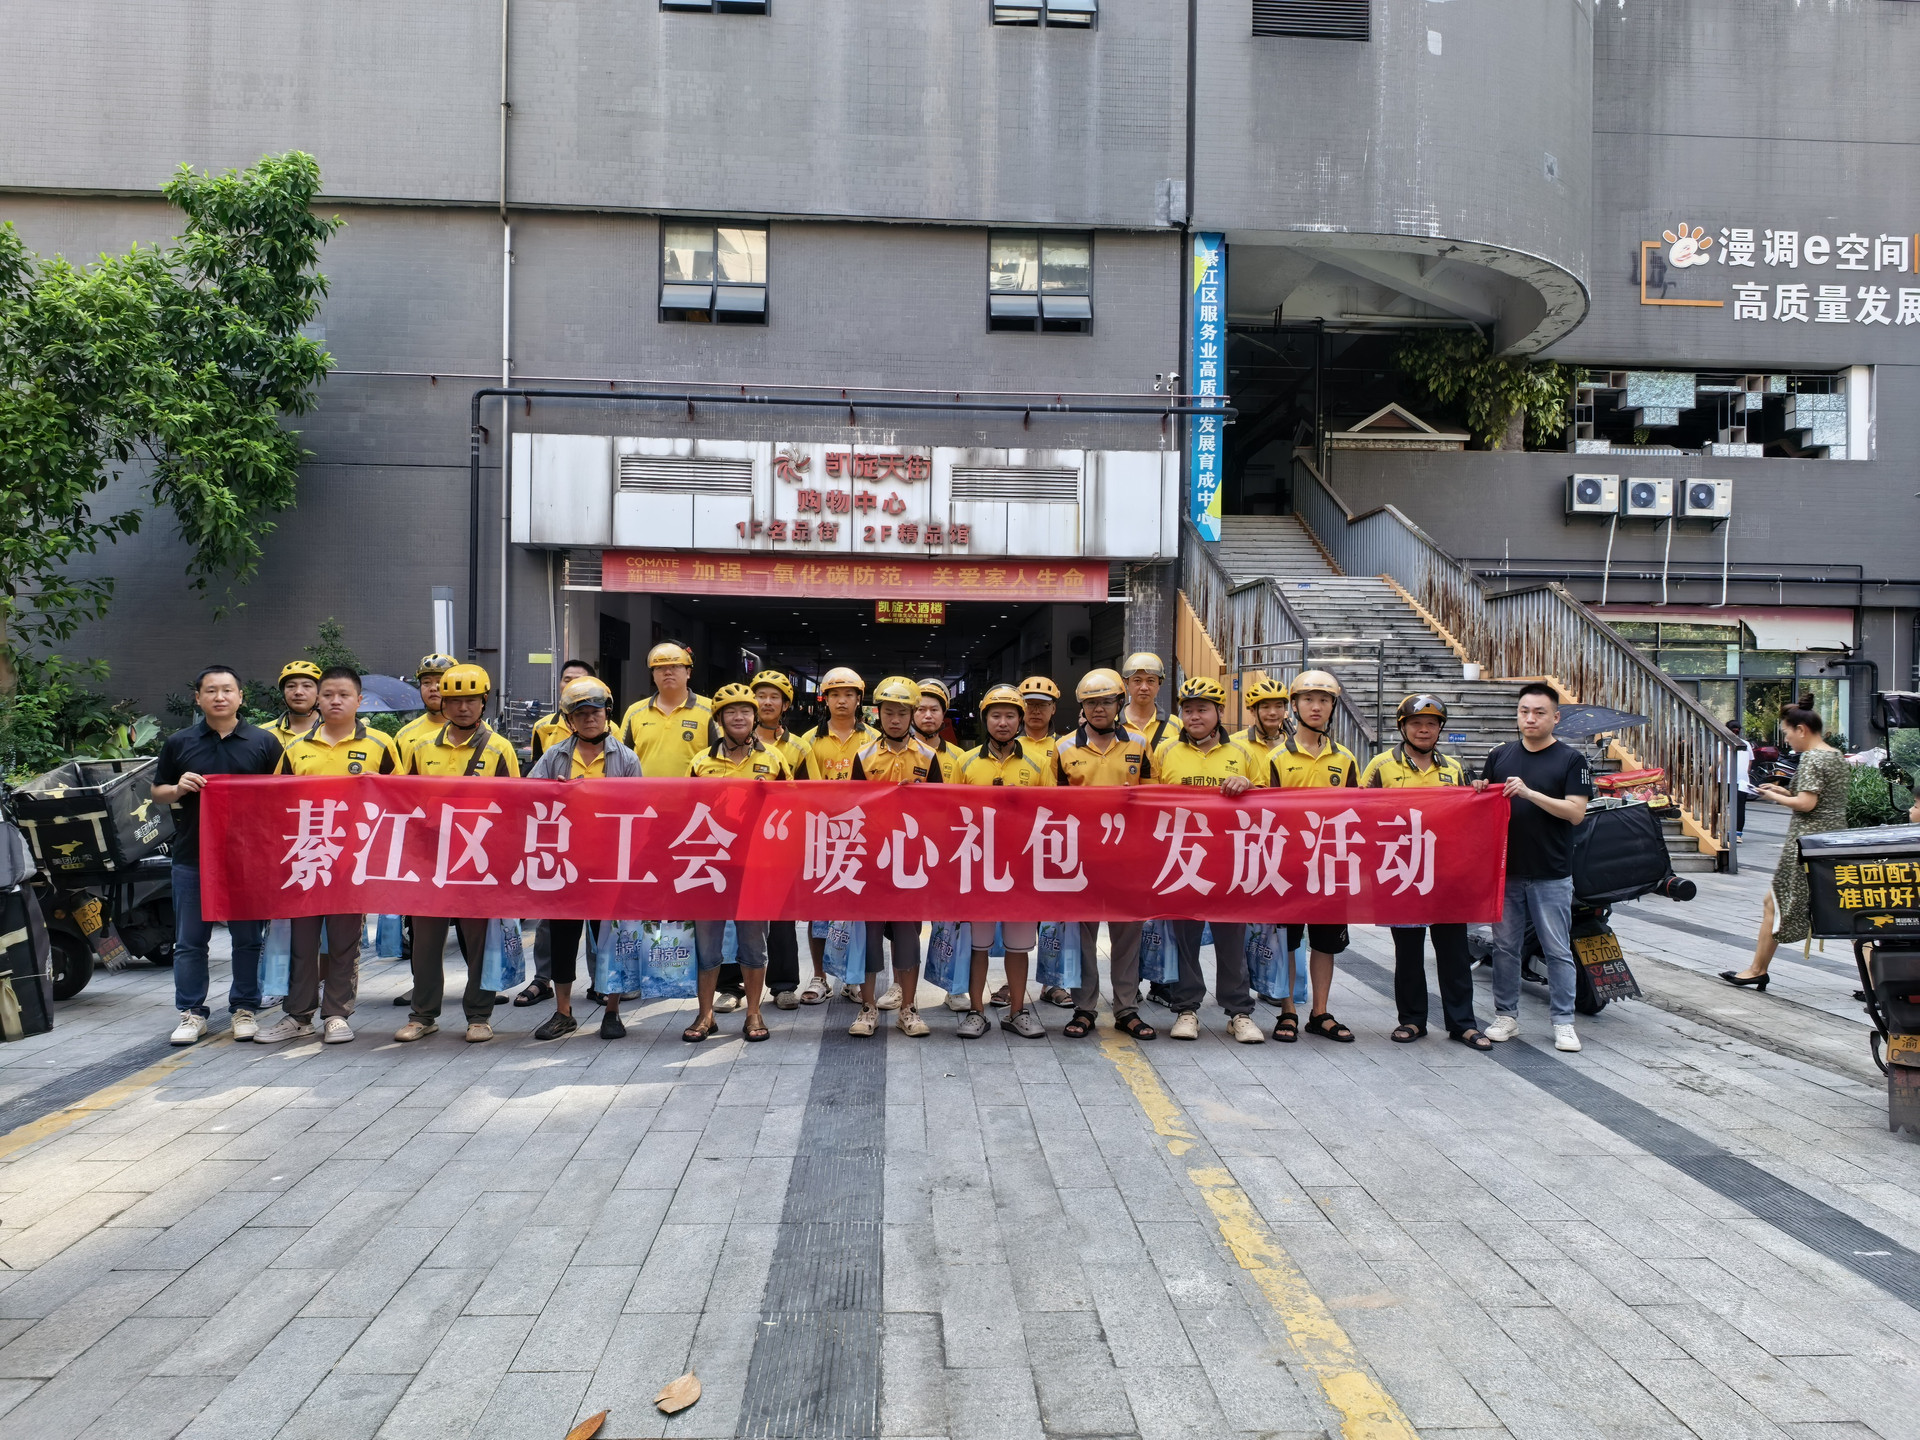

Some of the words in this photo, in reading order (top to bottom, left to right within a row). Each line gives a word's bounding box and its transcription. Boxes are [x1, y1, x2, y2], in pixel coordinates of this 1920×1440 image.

[1717, 226, 1910, 273] 漫调e空间
[825, 452, 932, 484] 凯旋天街
[797, 489, 907, 515] 购物中心
[736, 521, 839, 542] 1F名品街
[863, 523, 971, 545] 2F精品馆
[626, 557, 680, 568] COMATE
[878, 601, 943, 614] 凯旋大酒楼
[280, 799, 1438, 897] 綦江区总工会“暖心礼包”发放活动
[1836, 886, 1920, 909] 准时好
[648, 946, 691, 962] 清凉包
[1581, 946, 1621, 963] 737DB
